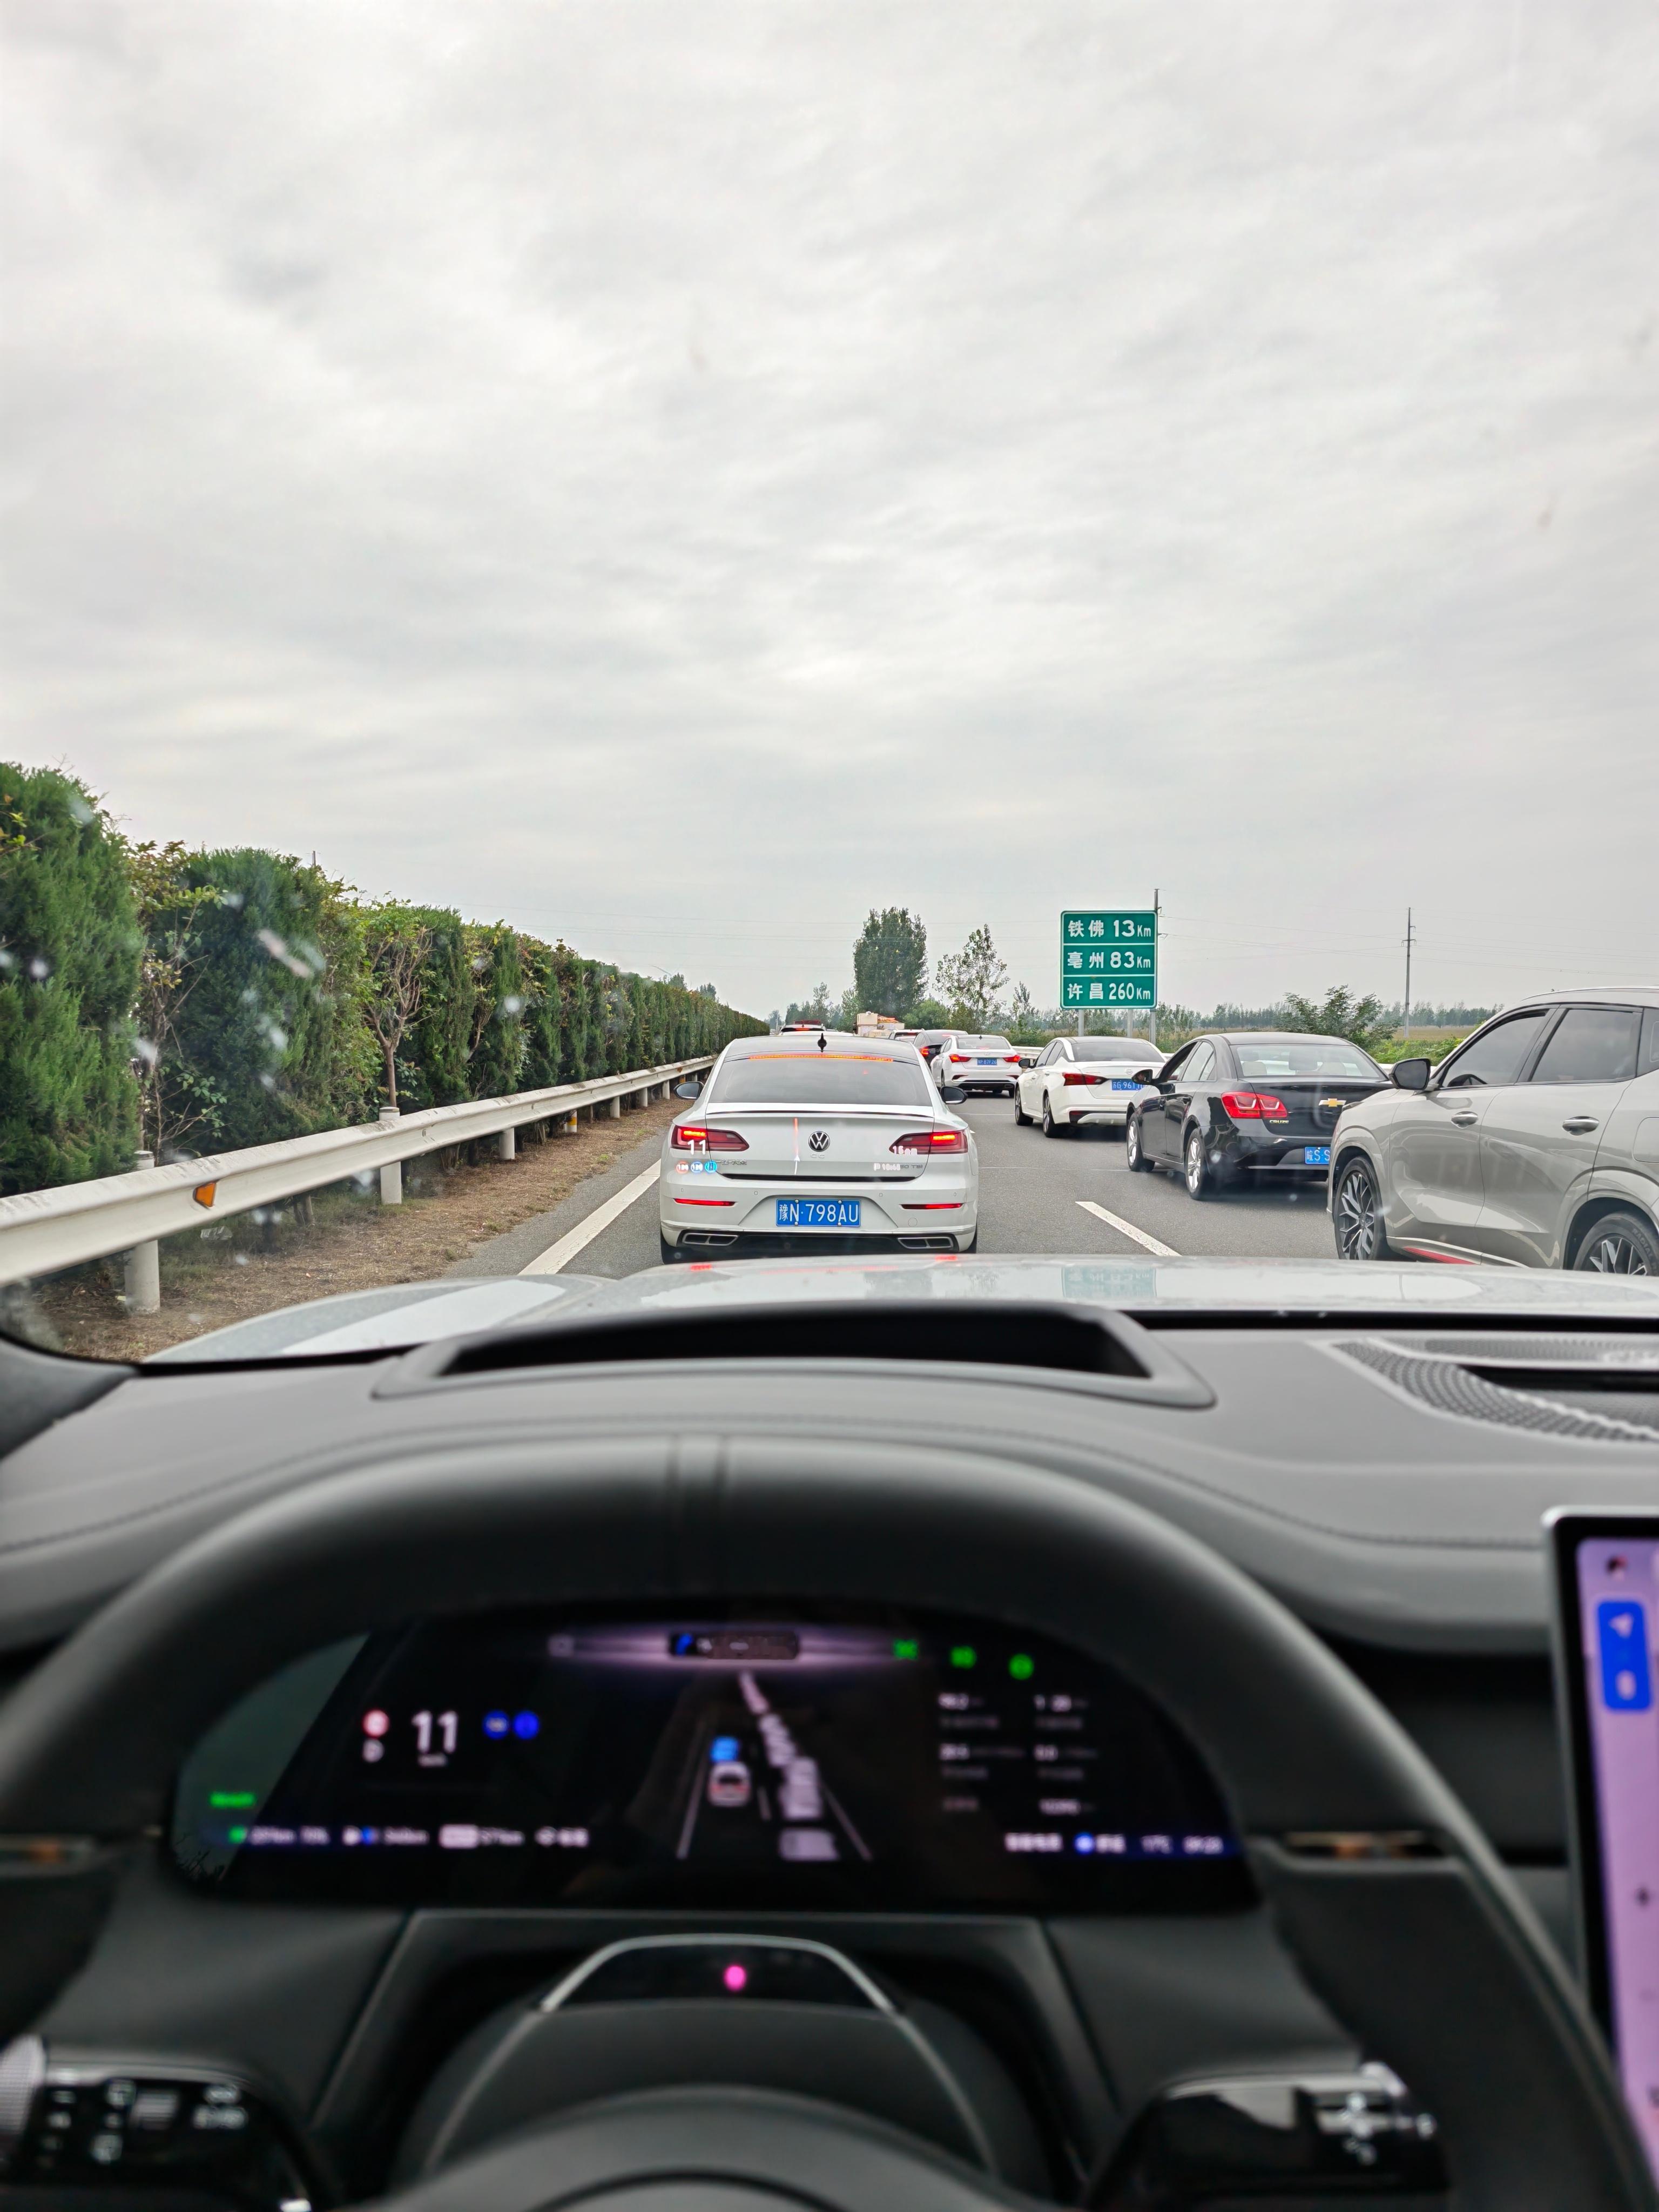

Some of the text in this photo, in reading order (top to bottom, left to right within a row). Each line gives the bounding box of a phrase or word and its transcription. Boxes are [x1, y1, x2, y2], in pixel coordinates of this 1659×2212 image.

[1068, 920, 1104, 938] 铁佛
[1067, 952, 1104, 969] 亳州
[1067, 983, 1103, 1000] 许昌
